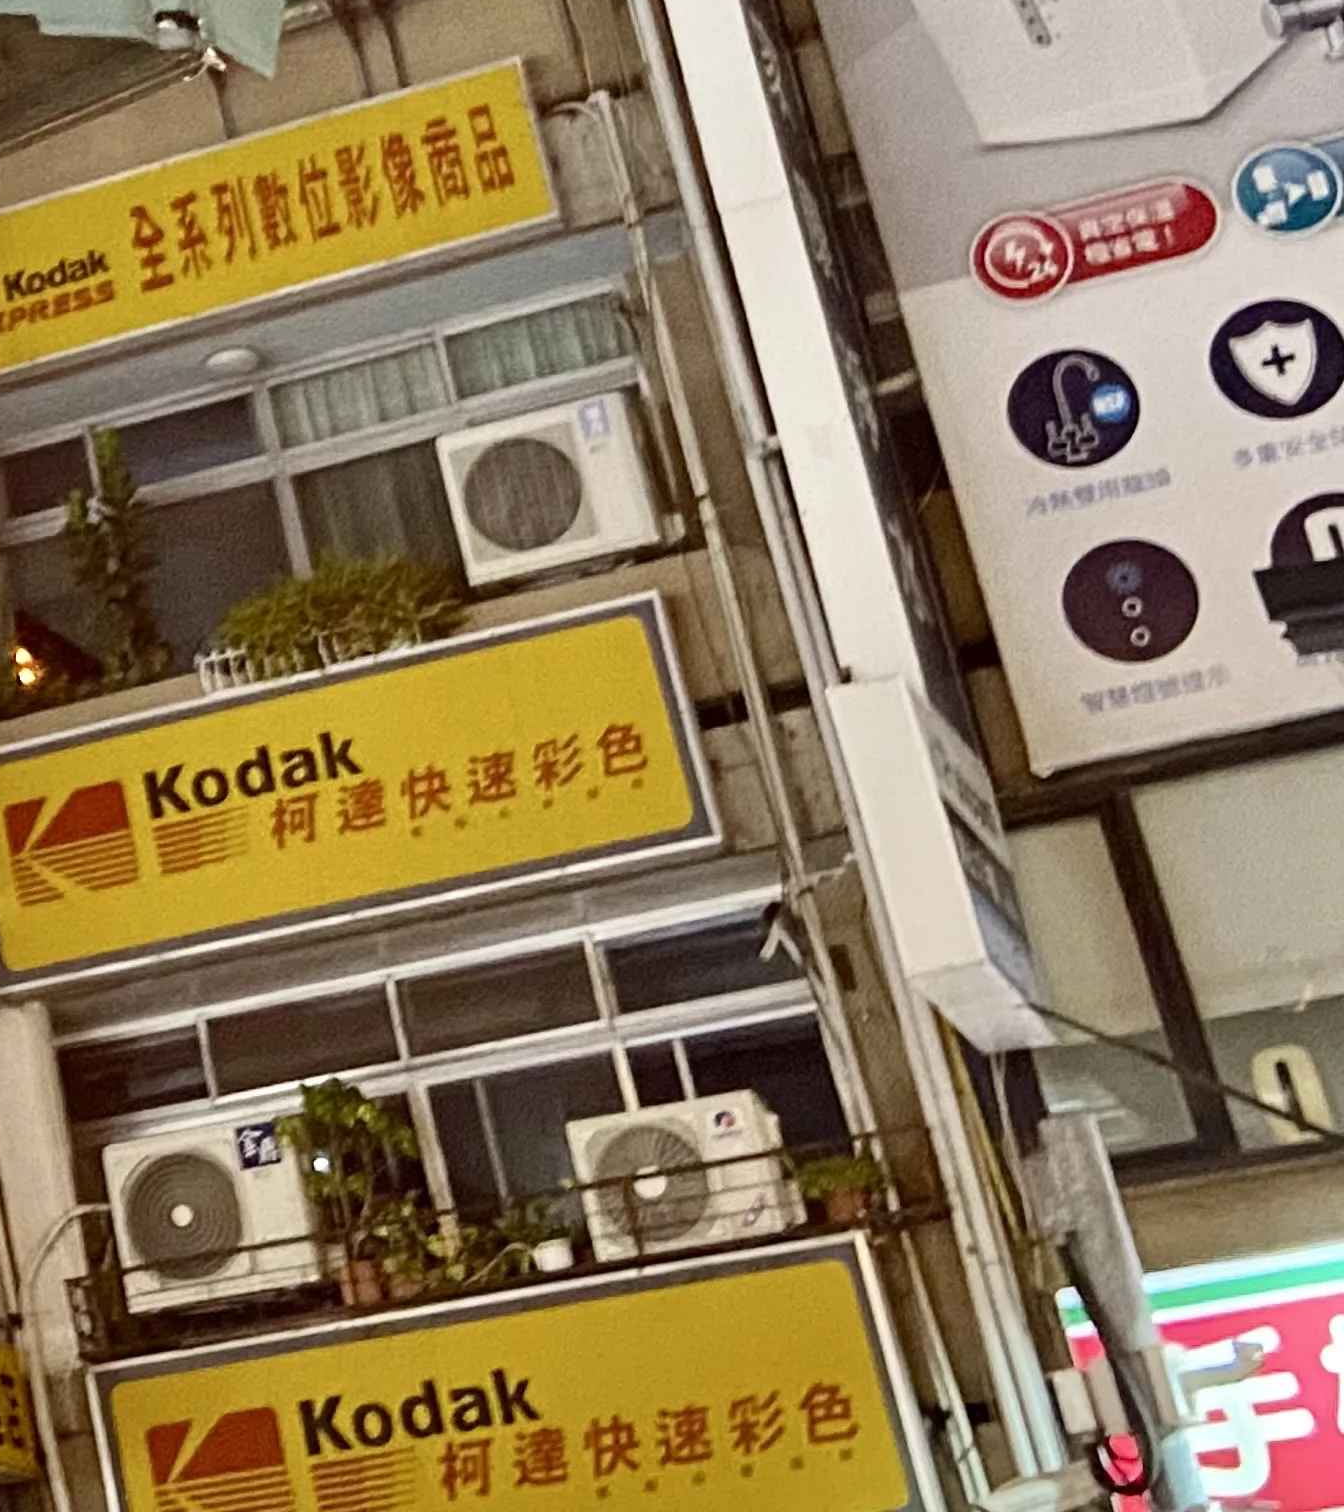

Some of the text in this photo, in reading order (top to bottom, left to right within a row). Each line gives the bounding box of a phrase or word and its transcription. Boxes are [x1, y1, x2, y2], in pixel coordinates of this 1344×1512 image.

[128, 103, 516, 294] 全系列數位影像商品
[2, 250, 111, 303] Kodak
[143, 730, 365, 820] Kodak
[270, 722, 651, 850] 柯達快速彩色
[299, 1368, 540, 1458] Kodak
[440, 1381, 861, 1501] 柯達快速彩色
